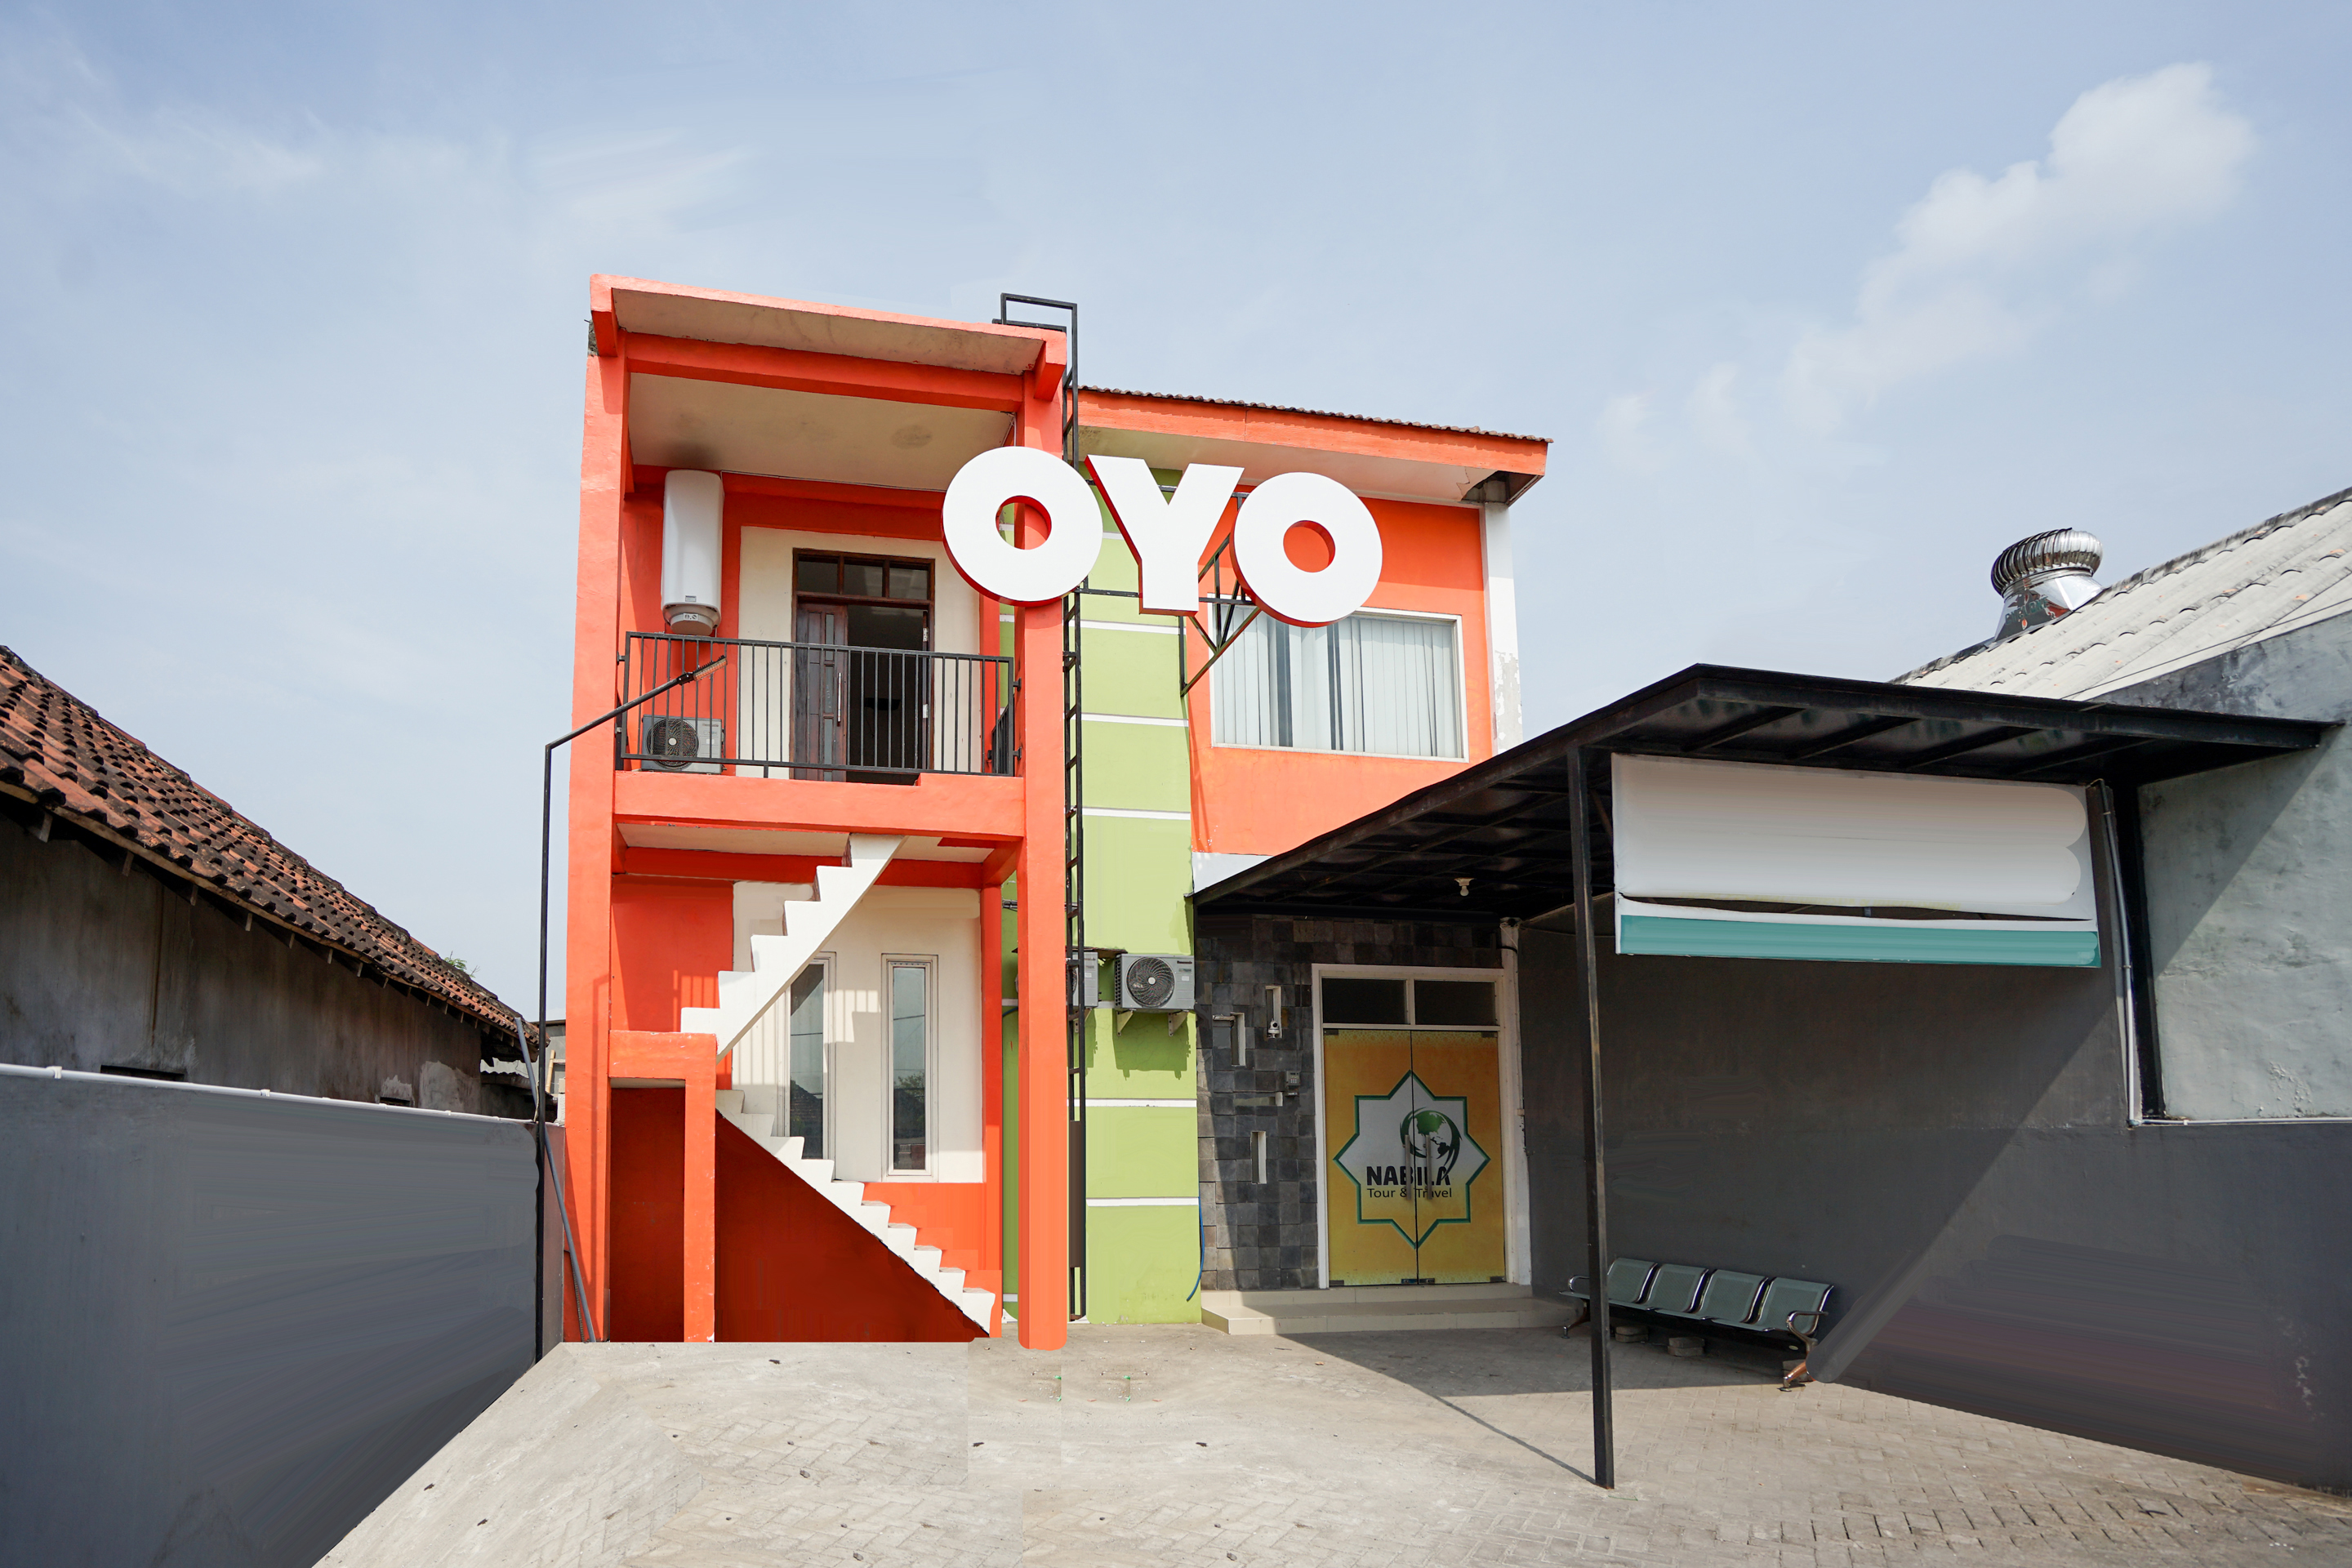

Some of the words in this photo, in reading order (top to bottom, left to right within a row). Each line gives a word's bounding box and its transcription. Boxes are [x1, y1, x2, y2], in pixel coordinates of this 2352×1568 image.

[940, 446, 1383, 628] OYO
[1366, 1165, 1451, 1186] NABILA
[1366, 1187, 1396, 1198] Tour
[1400, 1187, 1408, 1198] &
